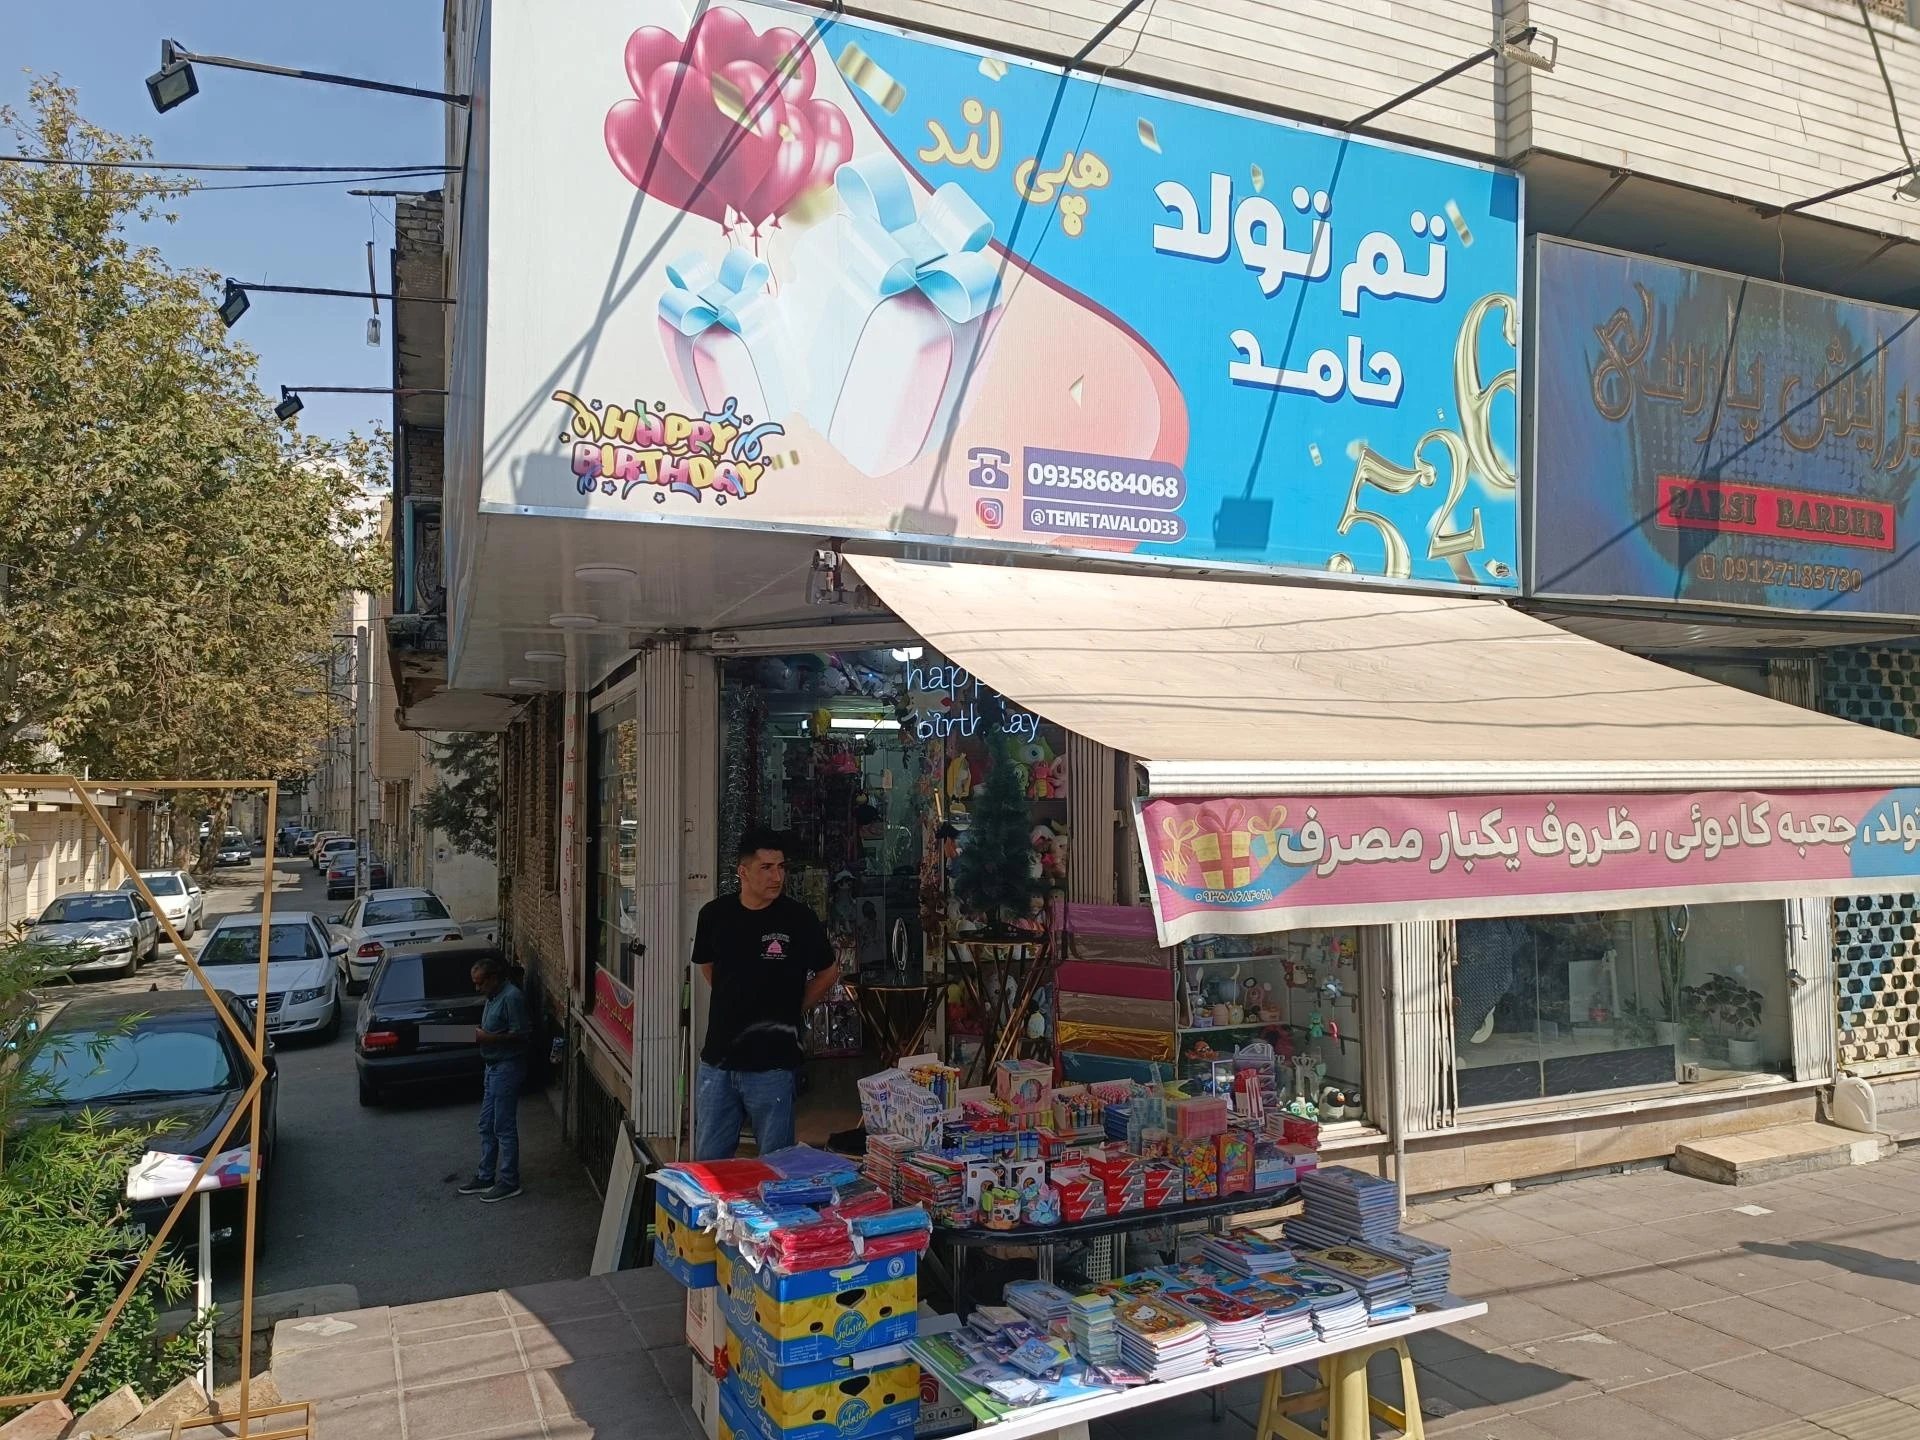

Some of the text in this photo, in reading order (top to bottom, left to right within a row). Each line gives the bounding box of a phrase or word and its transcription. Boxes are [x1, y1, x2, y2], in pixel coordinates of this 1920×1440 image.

[919, 98, 1111, 238] هپی لند
[1153, 172, 1449, 318] تم تولد
[1229, 329, 1405, 409] حامد
[602, 404, 740, 454] HAPPY
[572, 442, 766, 496] BIRTHDAY
[1027, 462, 1179, 499] 09358684068
[1030, 508, 1179, 536] @TEMETAVALOD33
[1669, 486, 1886, 541] PARSI BARBER
[1276, 805, 1424, 878] مصرف
[1429, 807, 1520, 873] یکبار
[1525, 800, 1641, 867] ظروف
[1777, 810, 1858, 858] جعبه
